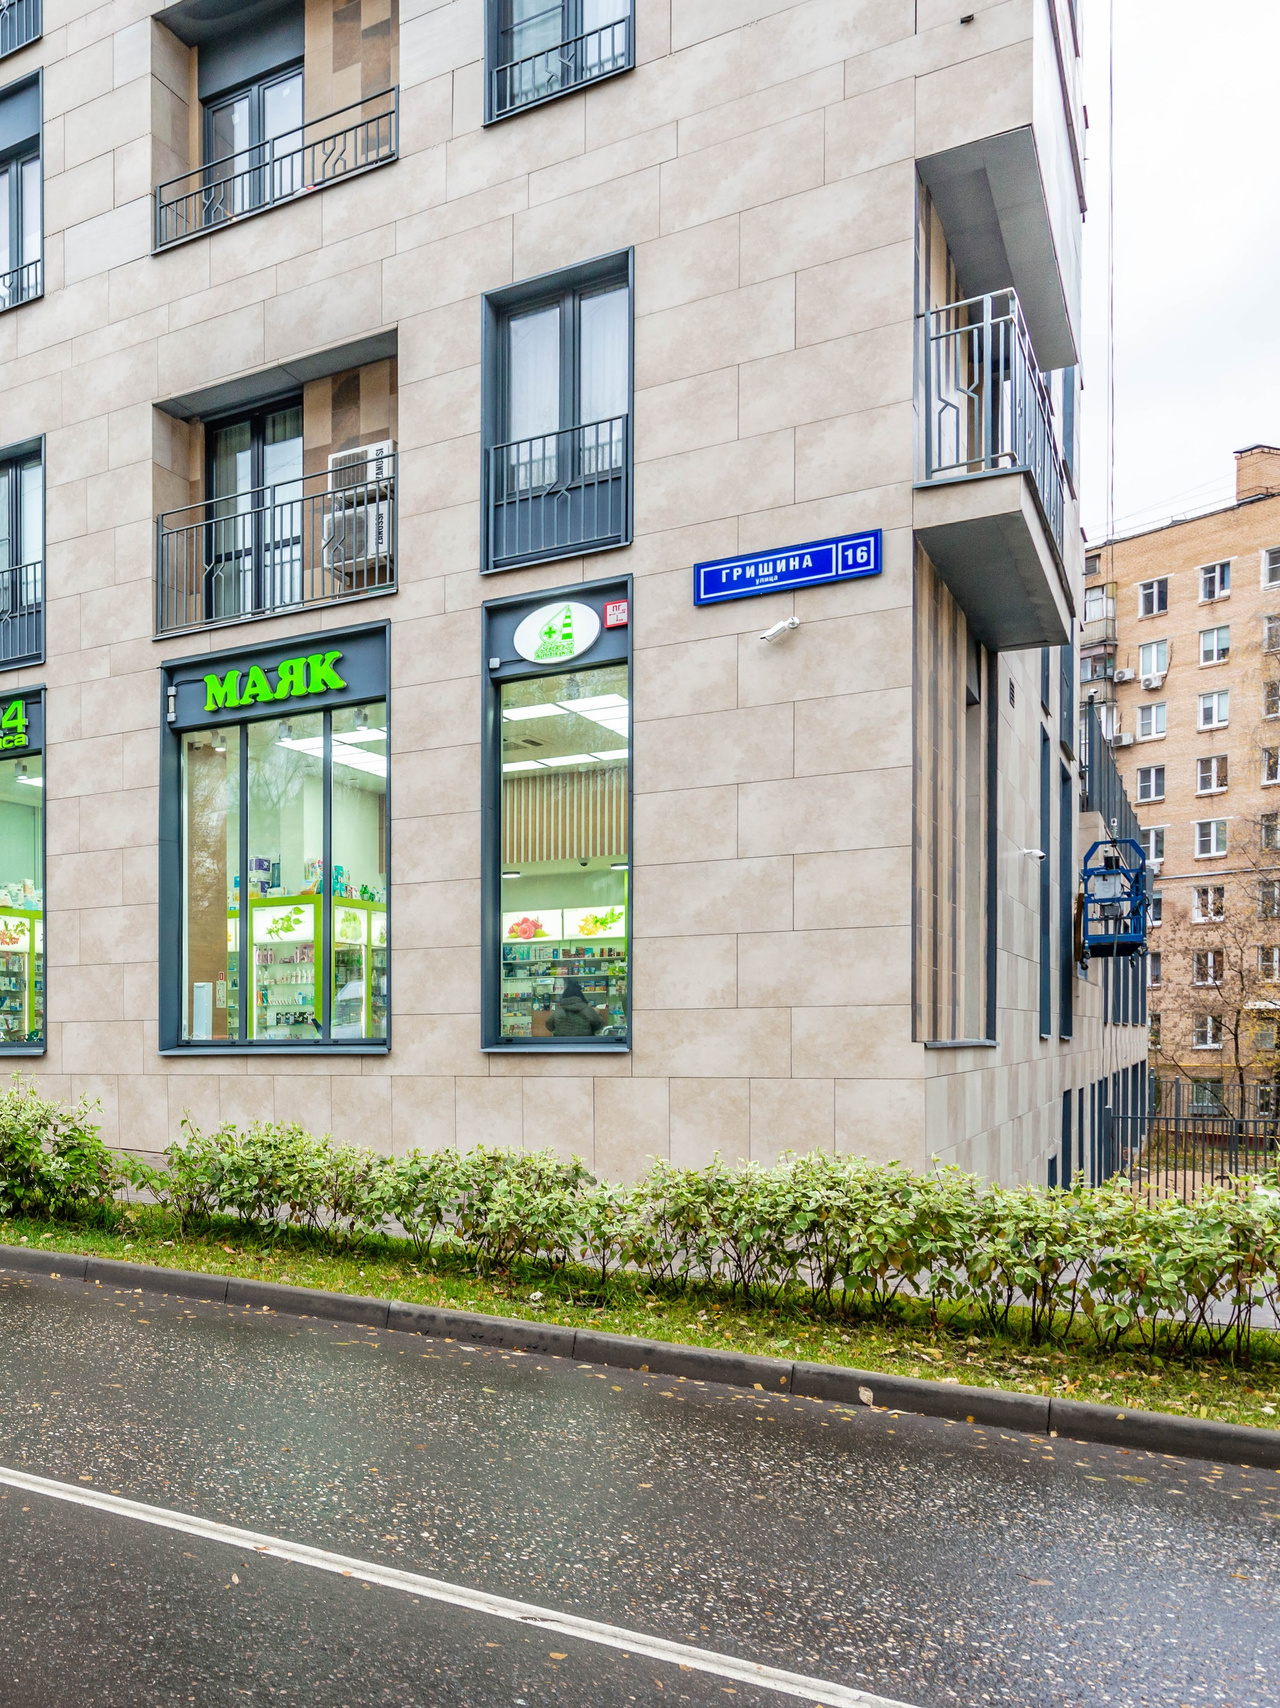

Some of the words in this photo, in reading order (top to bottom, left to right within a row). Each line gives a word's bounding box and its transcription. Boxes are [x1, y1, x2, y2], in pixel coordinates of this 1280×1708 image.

[375, 447, 384, 480] ZANUSI
[844, 546, 868, 565] 16
[721, 554, 813, 583] ГРИШИНА
[755, 574, 779, 585] улица
[612, 604, 622, 612] ПГ
[204, 650, 347, 712] МАЯК
